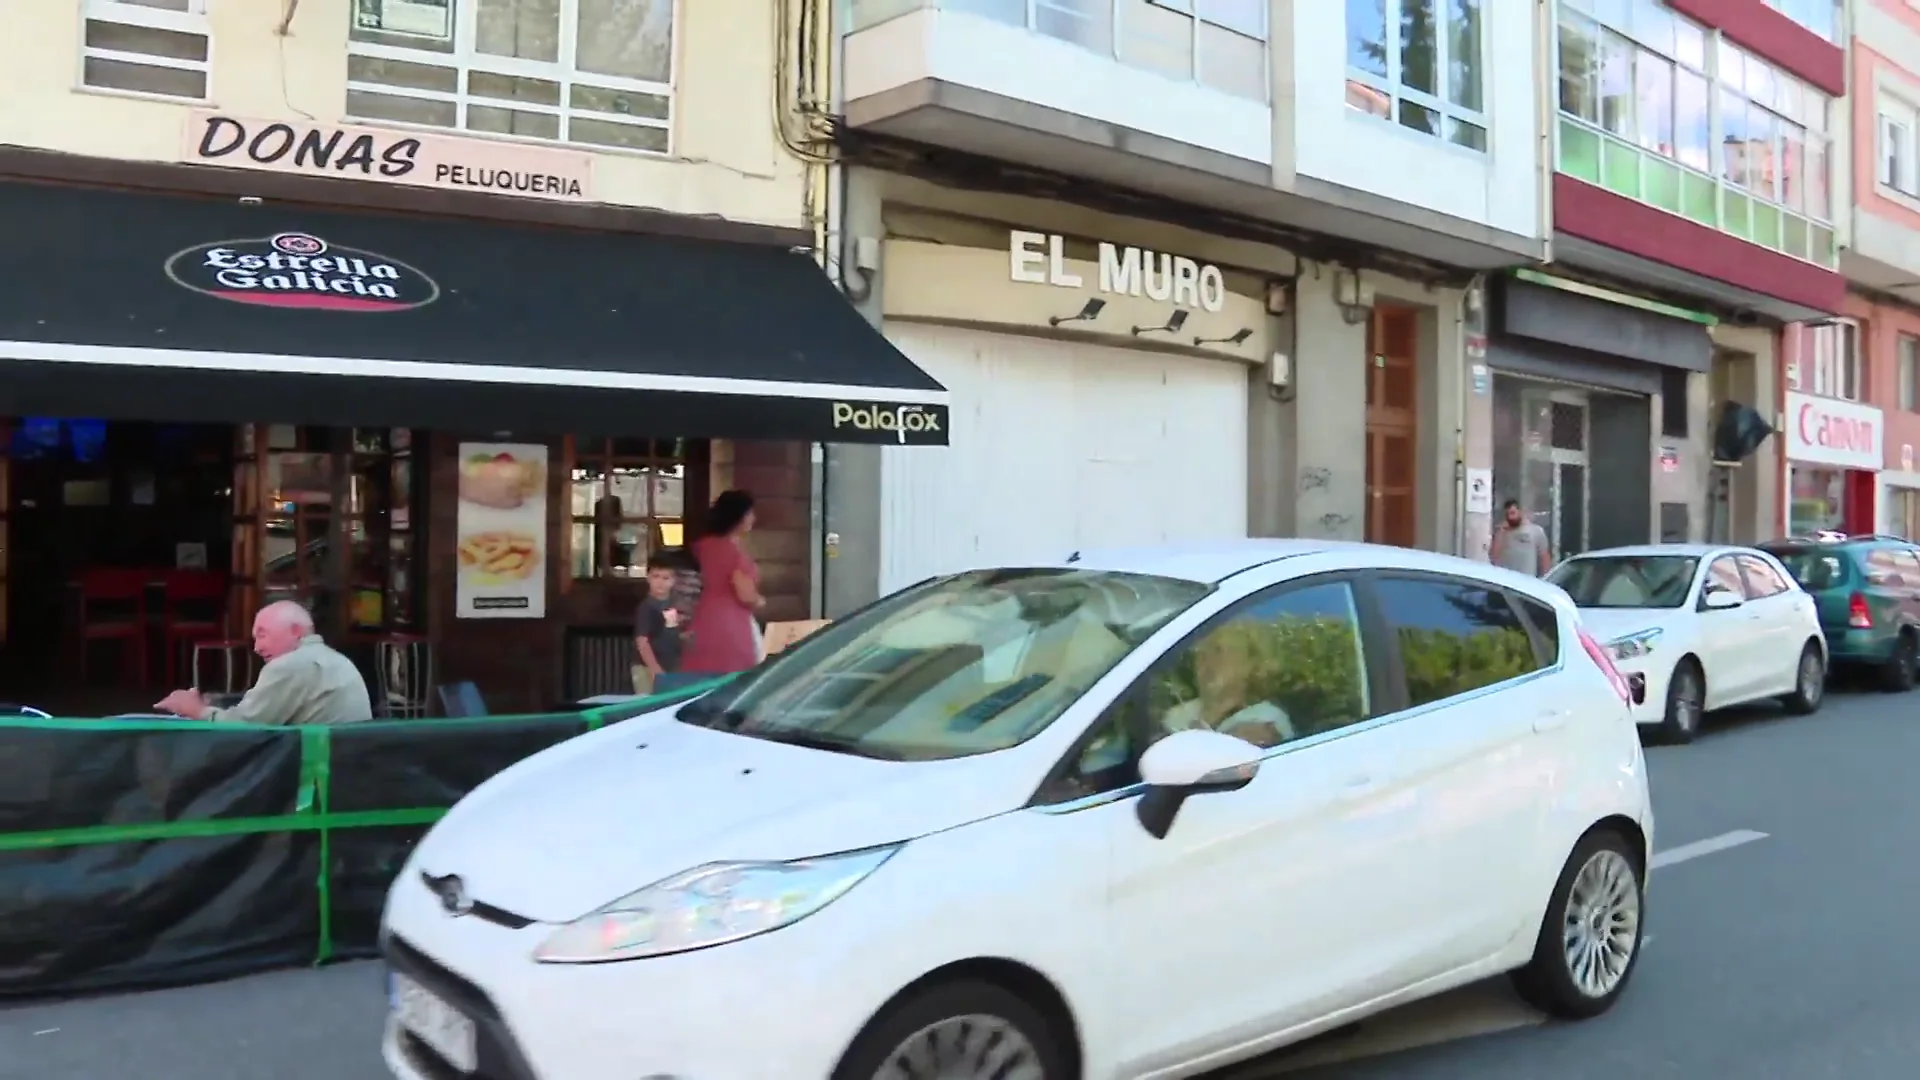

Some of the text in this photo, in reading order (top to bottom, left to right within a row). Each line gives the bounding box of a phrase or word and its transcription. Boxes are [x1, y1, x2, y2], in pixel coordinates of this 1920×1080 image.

[199, 117, 582, 196] DONAS PELUQUERIA
[203, 248, 400, 279] Estrella
[216, 268, 399, 298] Galicia
[1010, 230, 1225, 312] EL MURO
[833, 402, 941, 444] Palafox
